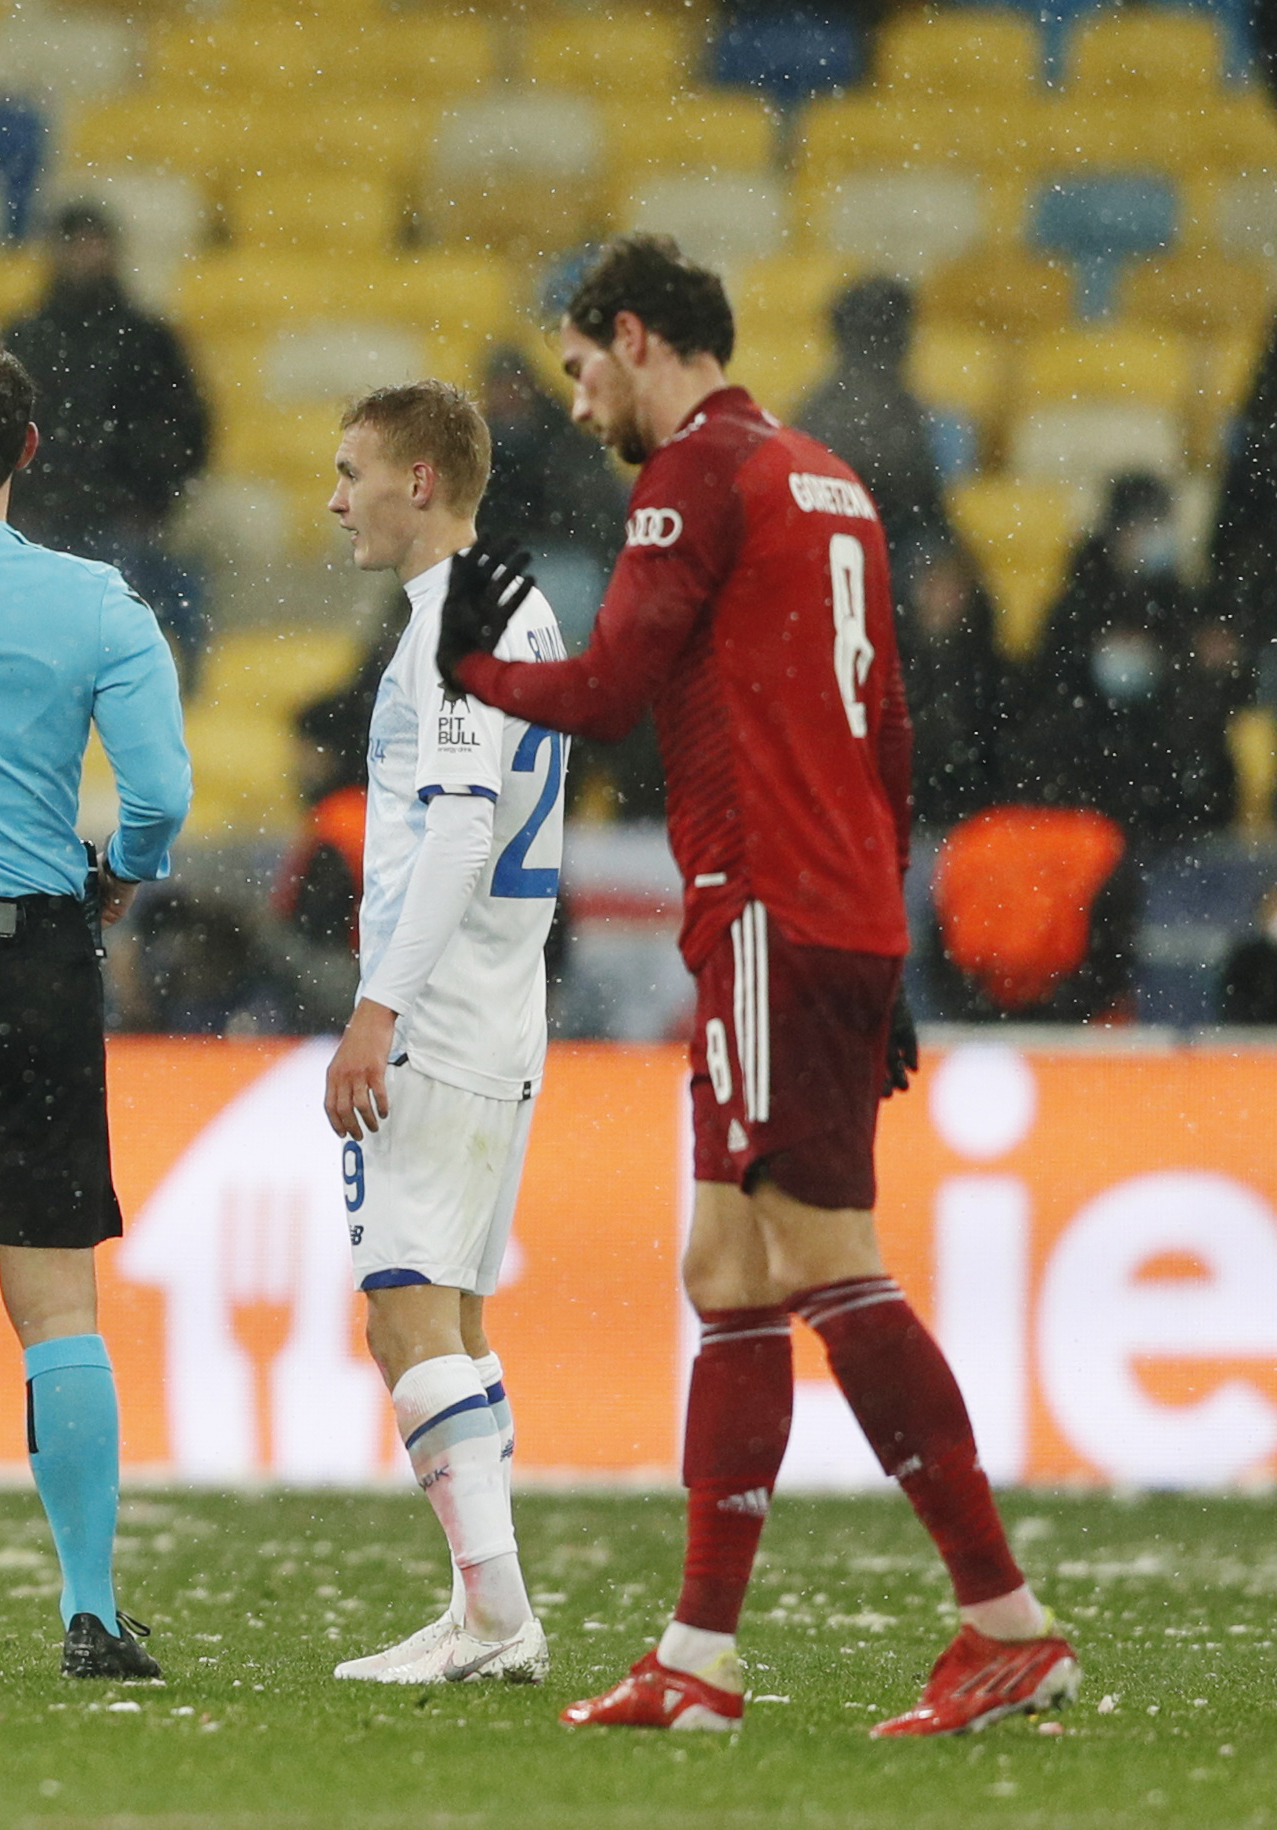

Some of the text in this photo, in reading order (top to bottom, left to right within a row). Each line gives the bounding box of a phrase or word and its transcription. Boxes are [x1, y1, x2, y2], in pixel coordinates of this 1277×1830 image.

[830, 533, 875, 738] 8
[438, 716, 465, 731] PIT
[438, 730, 481, 746] BULL
[706, 1018, 732, 1104] 8
